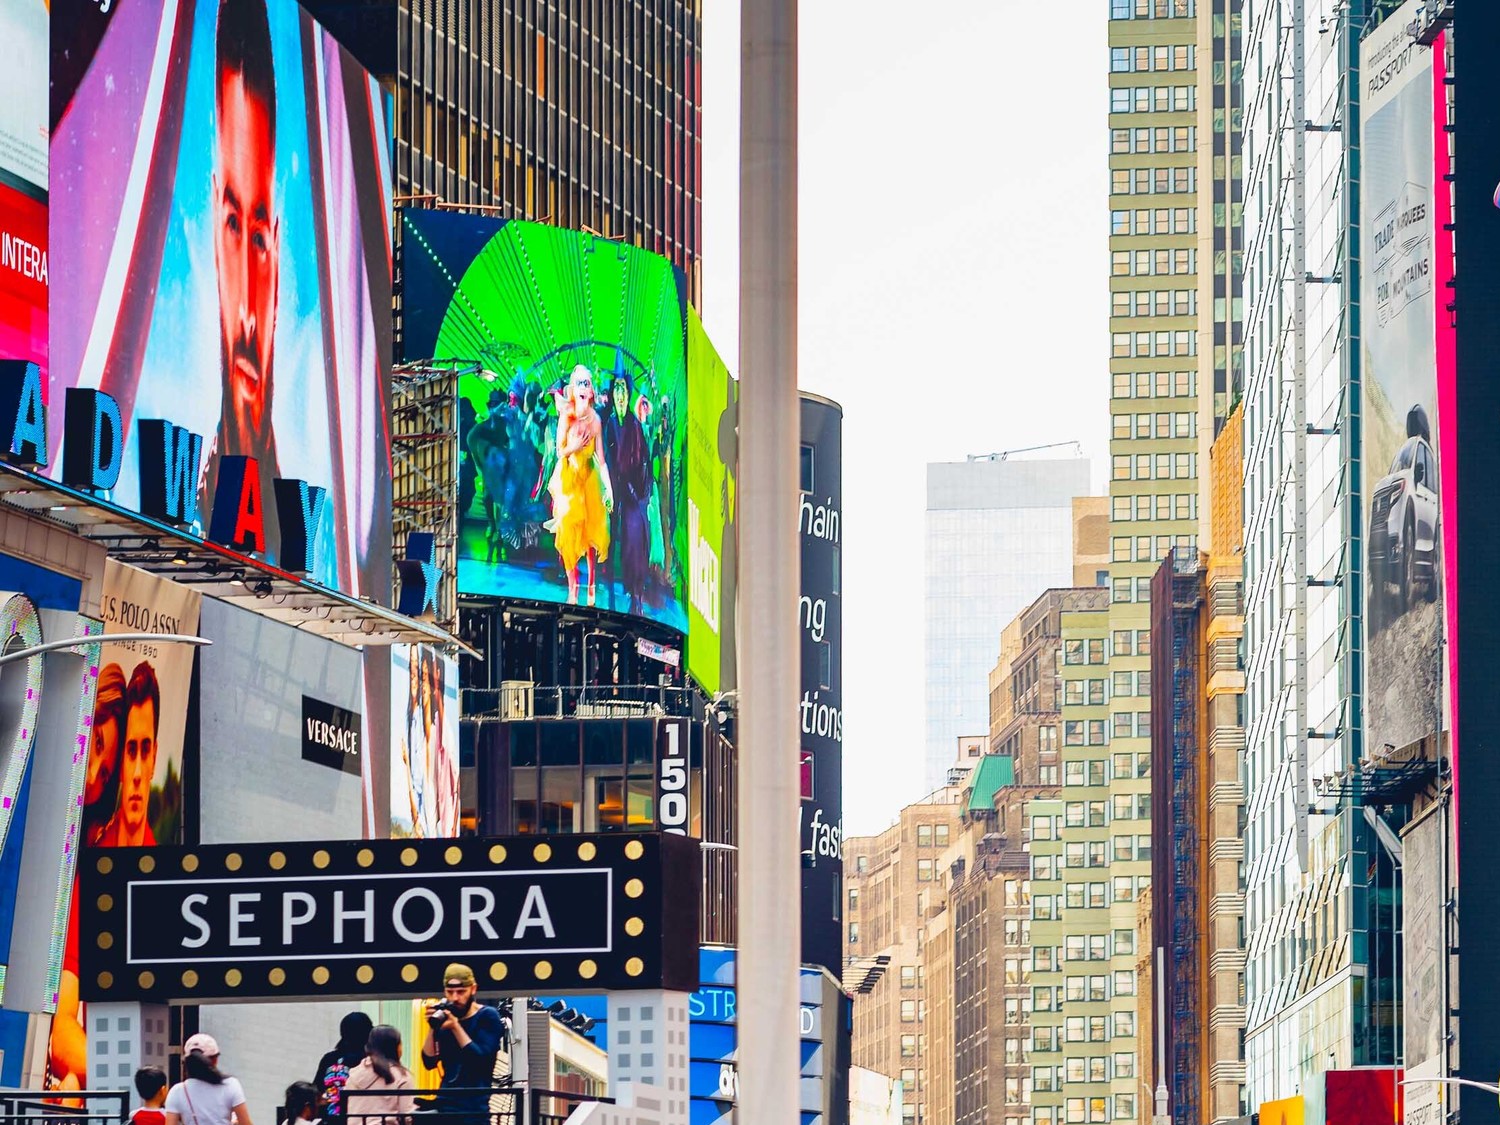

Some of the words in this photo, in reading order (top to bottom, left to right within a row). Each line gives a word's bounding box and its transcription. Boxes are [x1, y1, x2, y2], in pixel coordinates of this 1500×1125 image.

[1367, 46, 1413, 100] PASSPORT
[1374, 219, 1394, 254] TRADE
[120, 600, 150, 632] POLO
[306, 717, 359, 756] VERSACE
[659, 724, 688, 836] 150
[181, 885, 557, 949] SEPHORA
